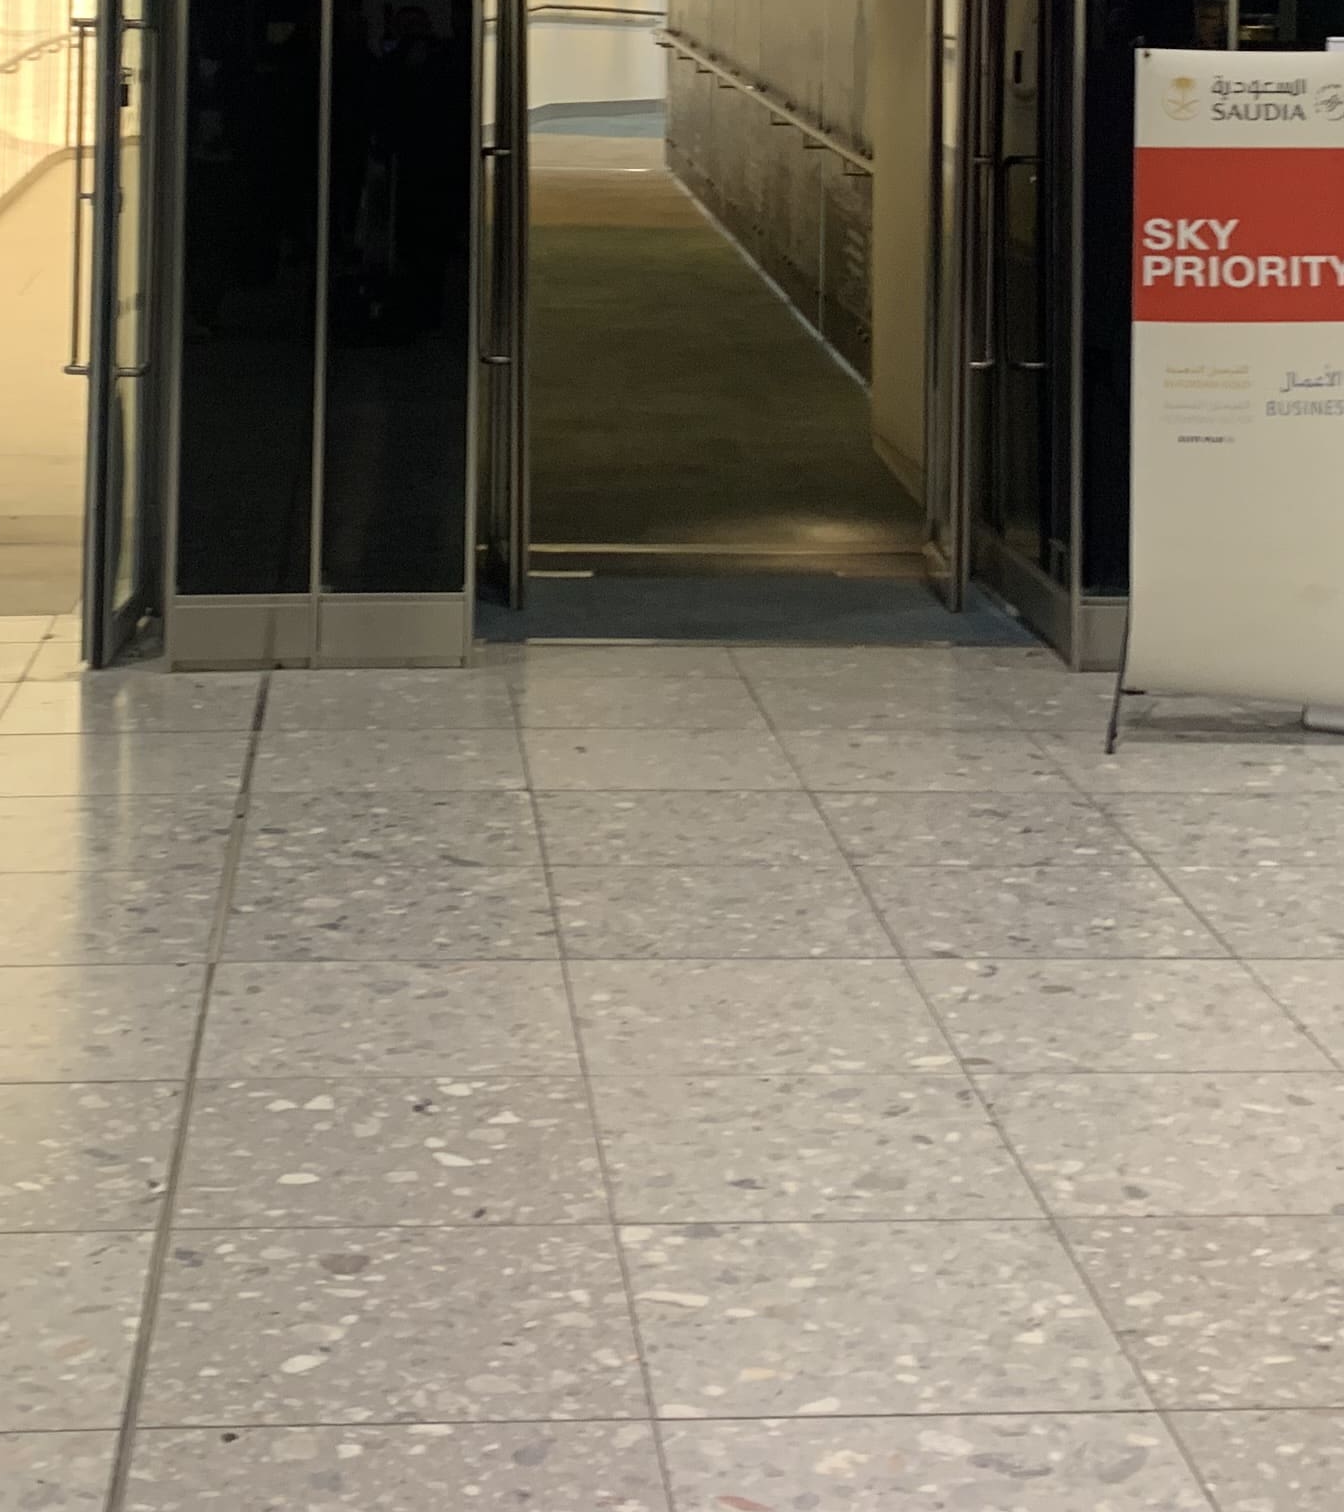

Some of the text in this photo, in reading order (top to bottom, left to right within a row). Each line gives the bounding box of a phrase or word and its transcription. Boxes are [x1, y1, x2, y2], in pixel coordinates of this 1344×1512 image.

[1211, 75, 1307, 100] السعودية
[1211, 103, 1306, 121] SAUDIA
[1142, 218, 1239, 251] SKY
